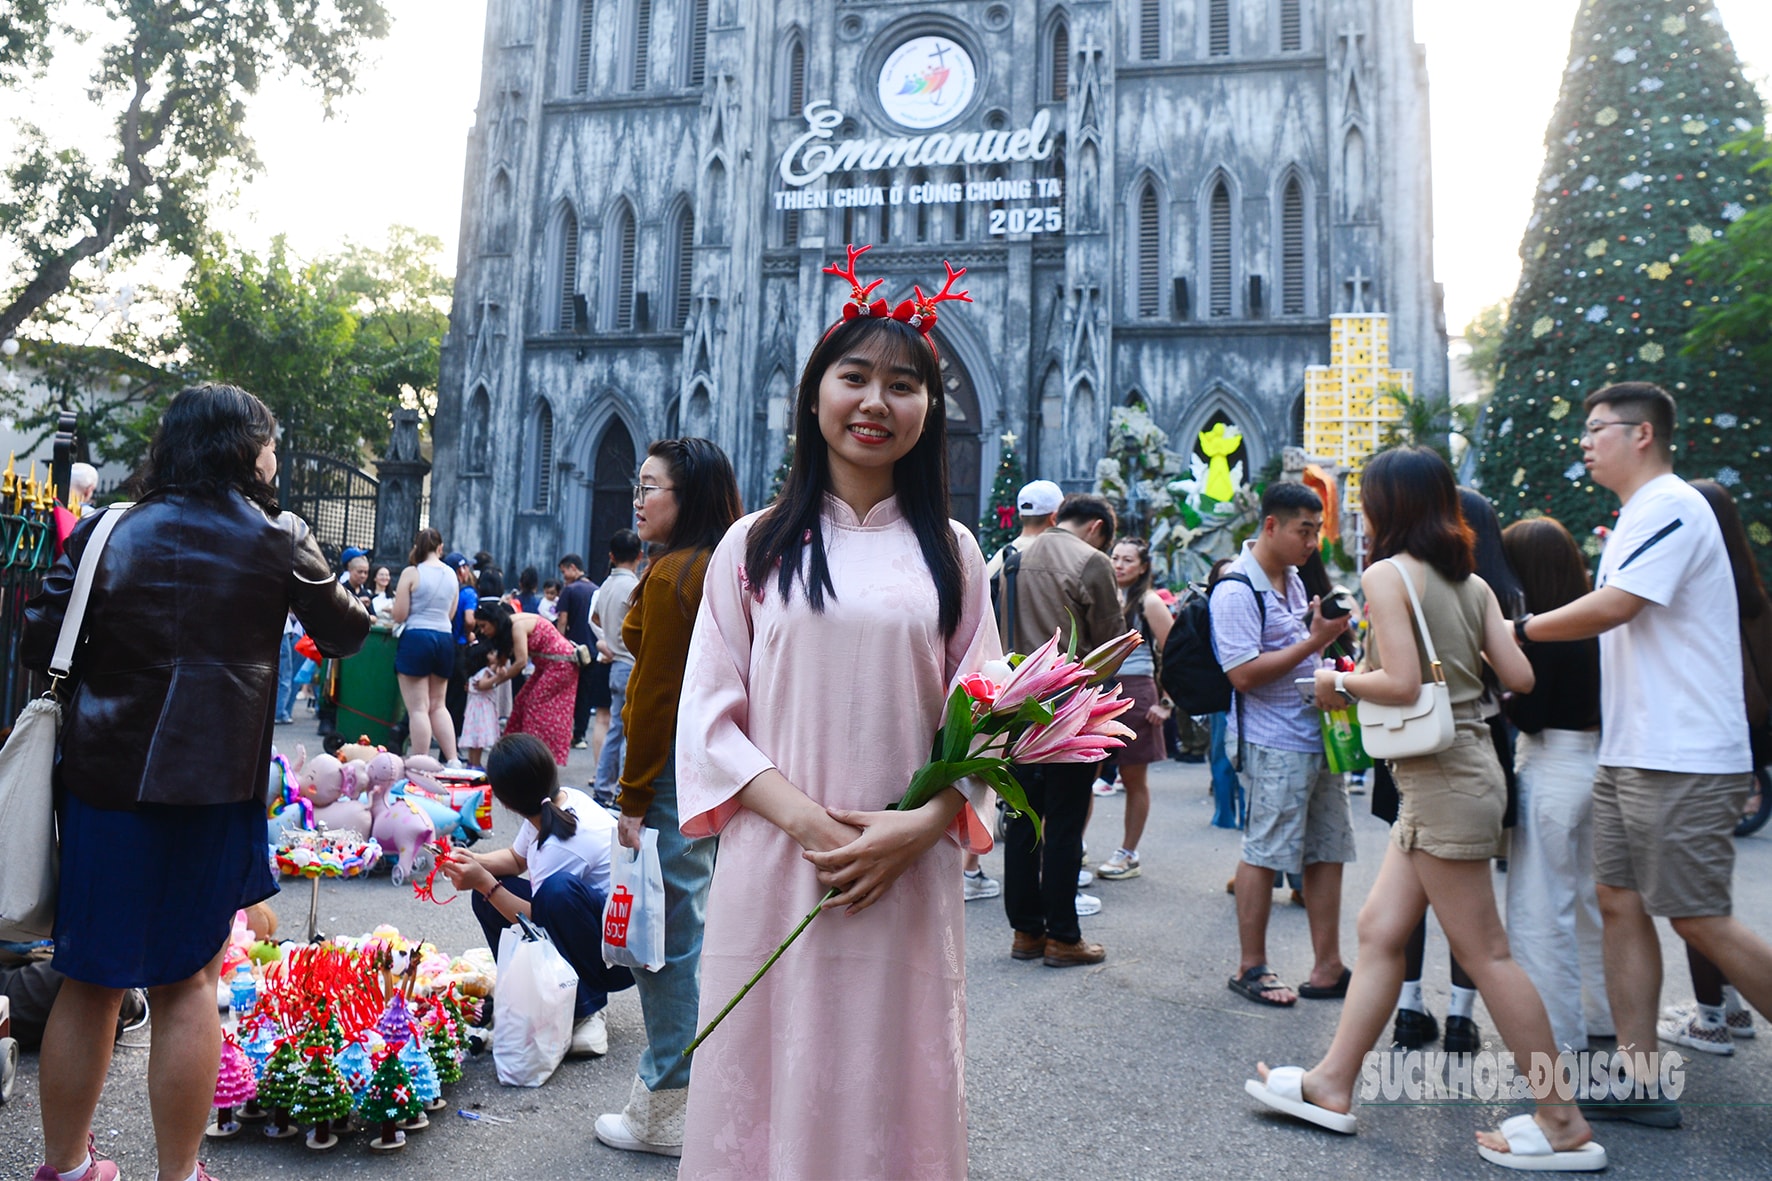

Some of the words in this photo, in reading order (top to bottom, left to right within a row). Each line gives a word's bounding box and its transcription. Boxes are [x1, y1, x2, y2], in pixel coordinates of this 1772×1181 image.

[779, 99, 1053, 186] Emmanuel
[833, 184, 885, 208] CHÚA
[965, 176, 1031, 202] CHÚNG
[1036, 178, 1062, 198] TA
[988, 206, 1062, 235] 2025
